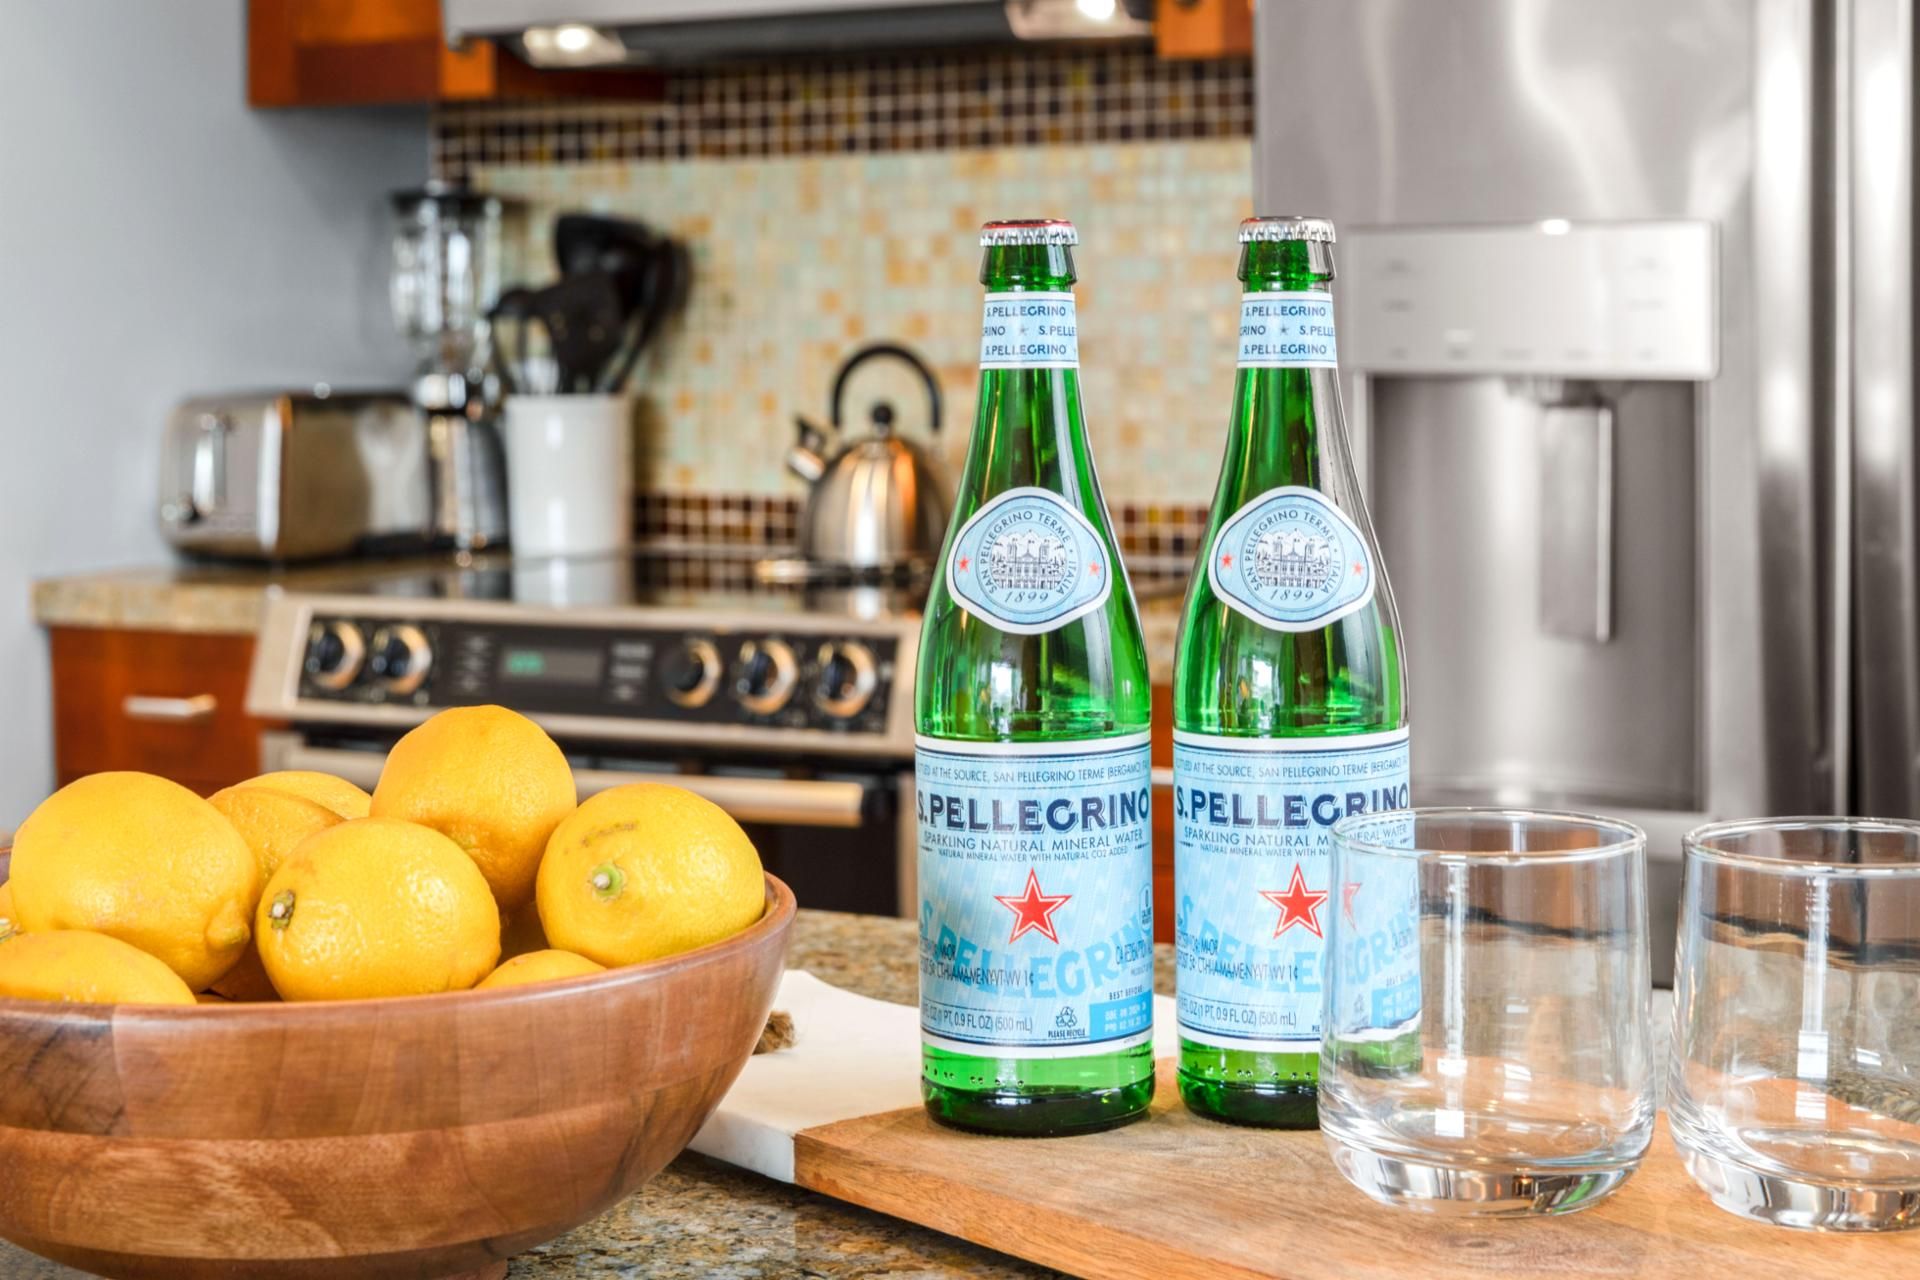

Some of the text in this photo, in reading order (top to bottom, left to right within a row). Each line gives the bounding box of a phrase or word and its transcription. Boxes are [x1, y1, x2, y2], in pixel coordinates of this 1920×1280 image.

[987, 305, 1066, 317] S.PELLEGRINO
[1245, 305, 1326, 317] S.PELLEGRINO
[985, 344, 1067, 356] S.PELLEGRINO
[1244, 344, 1327, 355] S.PELLEGRINO
[980, 510, 1033, 564] PELLEGRINO
[1038, 511, 1071, 543] TERME
[1244, 509, 1298, 562] PELLEGRINO
[1303, 511, 1336, 542] TERME
[981, 568, 998, 594] SAN
[1246, 566, 1263, 591] SAN
[1004, 591, 1049, 603] 1899
[1270, 589, 1314, 601] 1899
[994, 770, 1014, 782] SAN
[1017, 770, 1076, 783] PELLEGRINO
[1078, 768, 1105, 781] TERME
[1202, 762, 1215, 775] THE
[1258, 767, 1280, 778] SAN
[1282, 764, 1340, 778] PELLEGRINO
[1342, 762, 1368, 776] TERME
[918, 787, 1149, 834] S.PELLEGRINO
[1176, 782, 1409, 830] S.PELLEGRINO
[924, 828, 1143, 852] SPARKLING NATURAL MINERAL WATER
[1184, 826, 1240, 846] SPARKLING
[1246, 834, 1310, 847] NATURAL
[966, 850, 998, 862] MINERAL
[1000, 852, 1027, 862] WATER
[1030, 852, 1052, 862] WITH
[1057, 850, 1089, 862] NATURAL
[1230, 846, 1261, 858] MINERAL
[1265, 848, 1293, 858] WATER
[1294, 848, 1316, 858] WITH
[954, 1012, 966, 1028] 0.9
[967, 1014, 976, 1028] FL
[979, 1016, 993, 1032] OZ)
[1016, 1016, 1033, 1034] mL)
[1229, 1008, 1240, 1024] FL
[1241, 1010, 1257, 1026] OZ)
[1280, 1012, 1297, 1030] mL)
[1048, 1028, 1086, 1038] PLEASE RECYCLE
